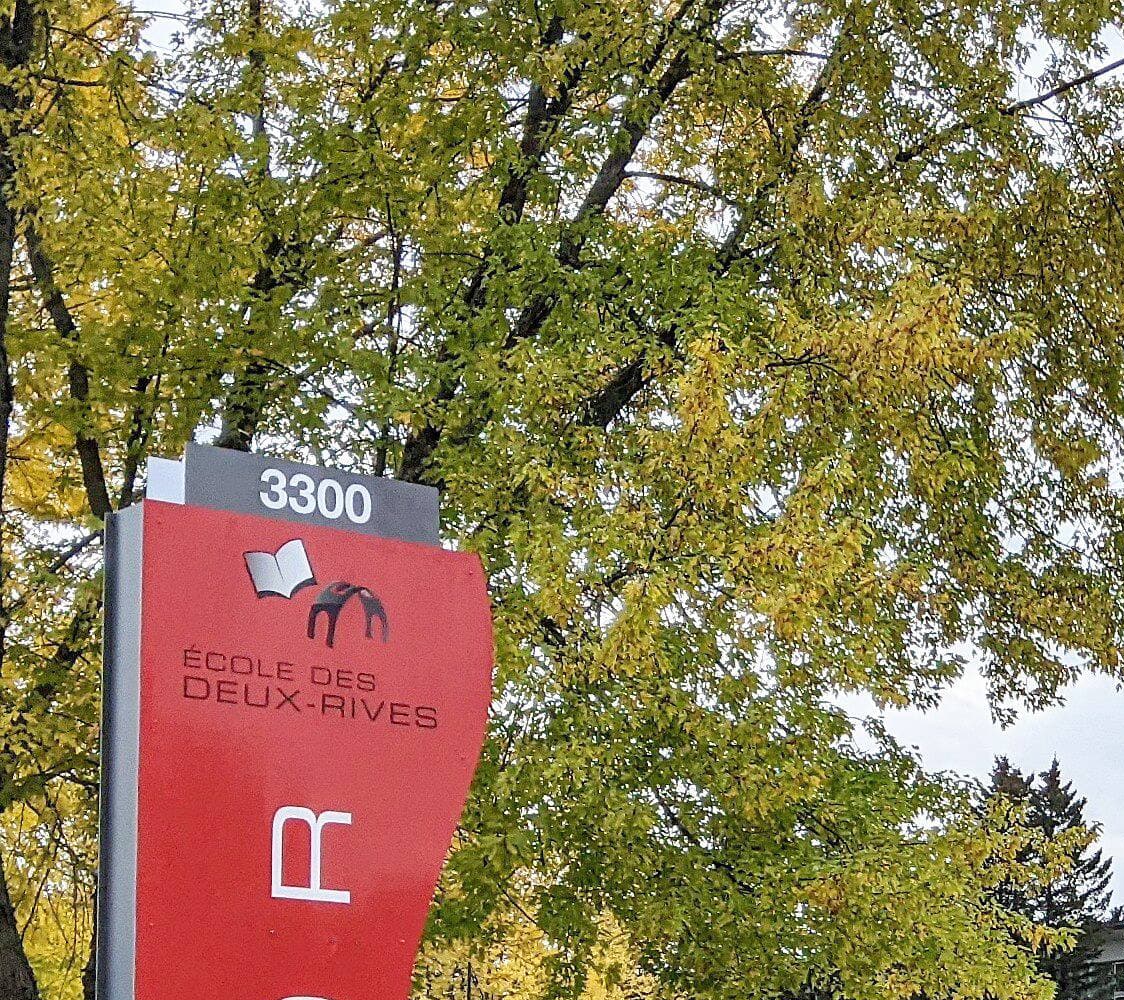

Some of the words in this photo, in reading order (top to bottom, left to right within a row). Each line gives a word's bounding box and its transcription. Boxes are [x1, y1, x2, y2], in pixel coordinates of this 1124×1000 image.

[259, 468, 372, 524] 3300
[183, 644, 295, 682] ÉCOLE
[310, 666, 376, 693] DES
[183, 675, 438, 730] DEUX-RIVES
